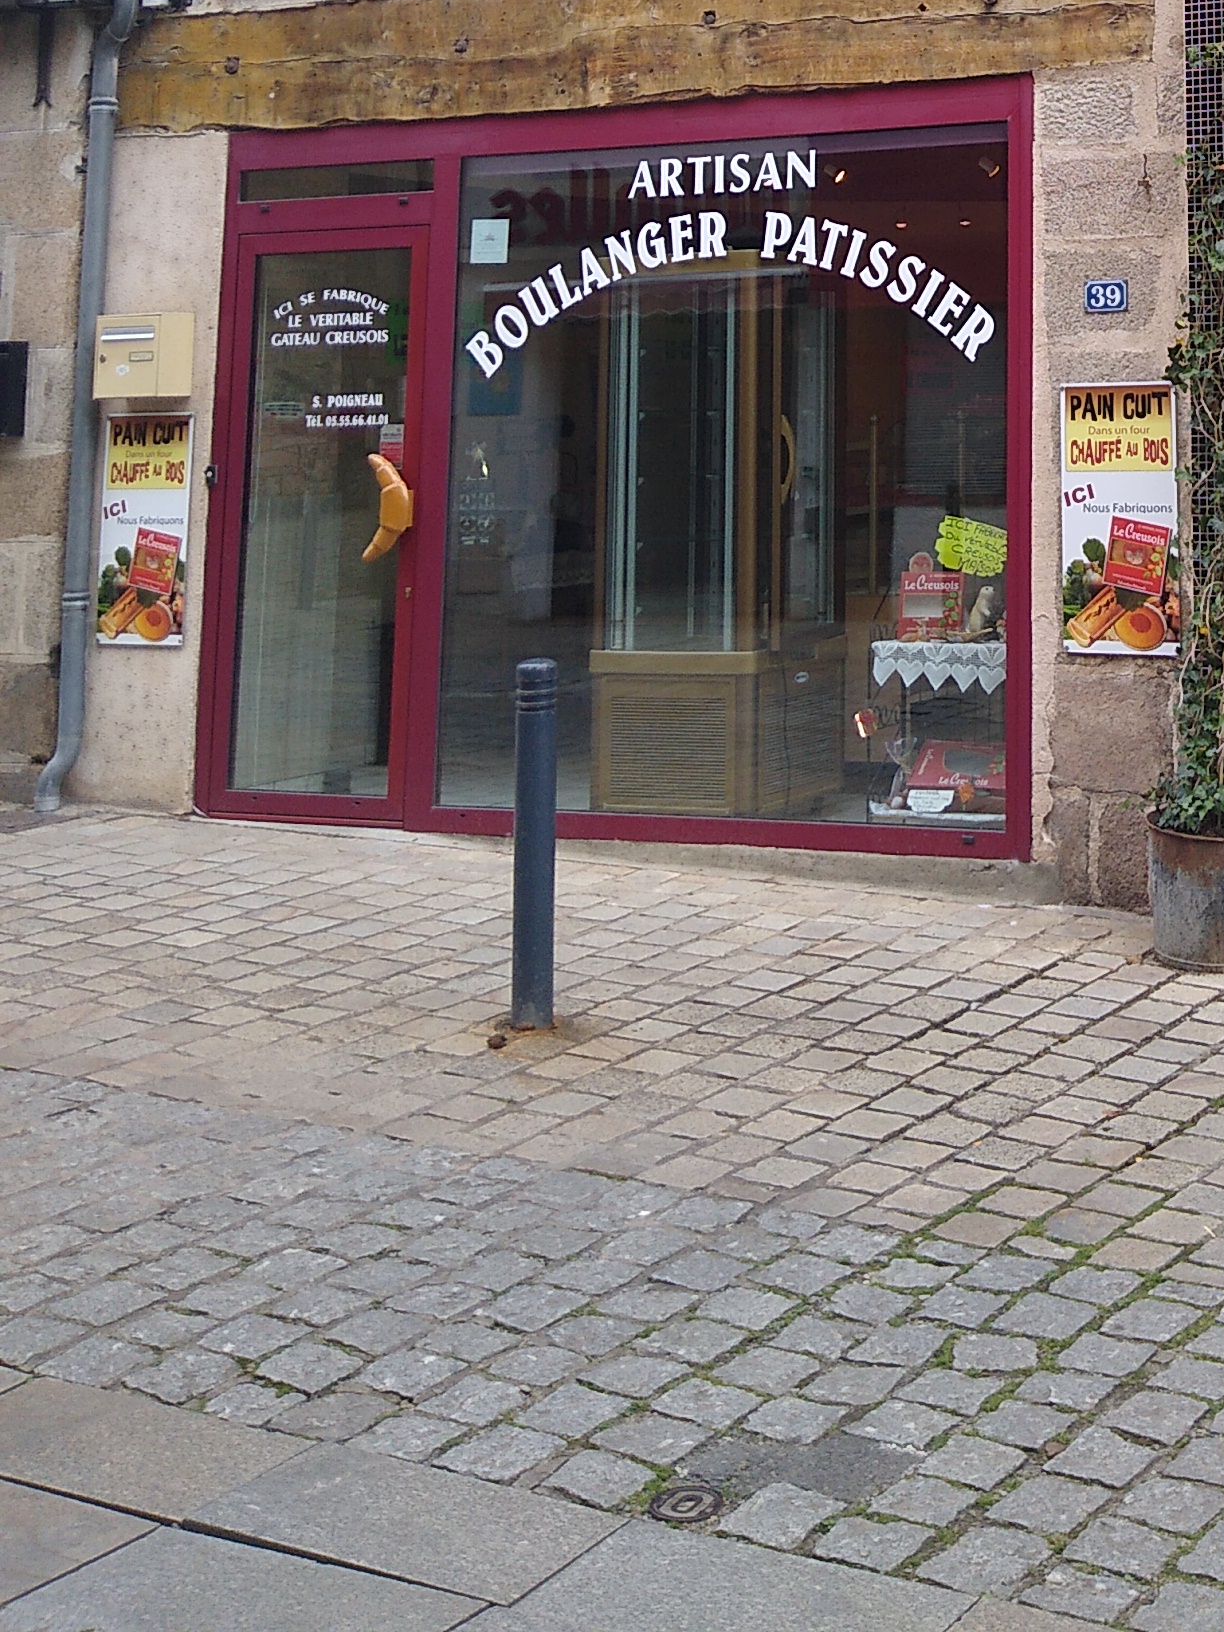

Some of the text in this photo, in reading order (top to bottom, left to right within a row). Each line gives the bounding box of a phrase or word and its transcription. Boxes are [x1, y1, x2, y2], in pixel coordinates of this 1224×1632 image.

[628, 149, 817, 199] ARTISAN
[274, 289, 390, 319] ICI SE FABRIQUE
[464, 210, 998, 379] BOULANGER PATISSIER
[1091, 284, 1121, 308] 39
[288, 312, 374, 327] LE VERITABLE
[271, 330, 389, 346] GATEAU CREUSOIS
[312, 394, 383, 407] S. POIGNEAU
[1070, 391, 1169, 422] PAIN CUIT
[112, 421, 189, 447] PAIN CUIT
[1088, 424, 1150, 435] Dans un four
[125, 449, 143, 459] Dans
[156, 449, 173, 458] four
[1070, 436, 1169, 466] CHAUFFÉ AU BOIS
[165, 460, 186, 486] BOIS
[1064, 483, 1095, 508] ICI
[103, 499, 128, 521] ICI
[1082, 502, 1173, 516] Nous Fabriquons
[117, 515, 184, 528] Nous Fabriquons
[946, 518, 972, 531] ICI
[946, 532, 960, 541] Du
[916, 574, 960, 592] Creusois
